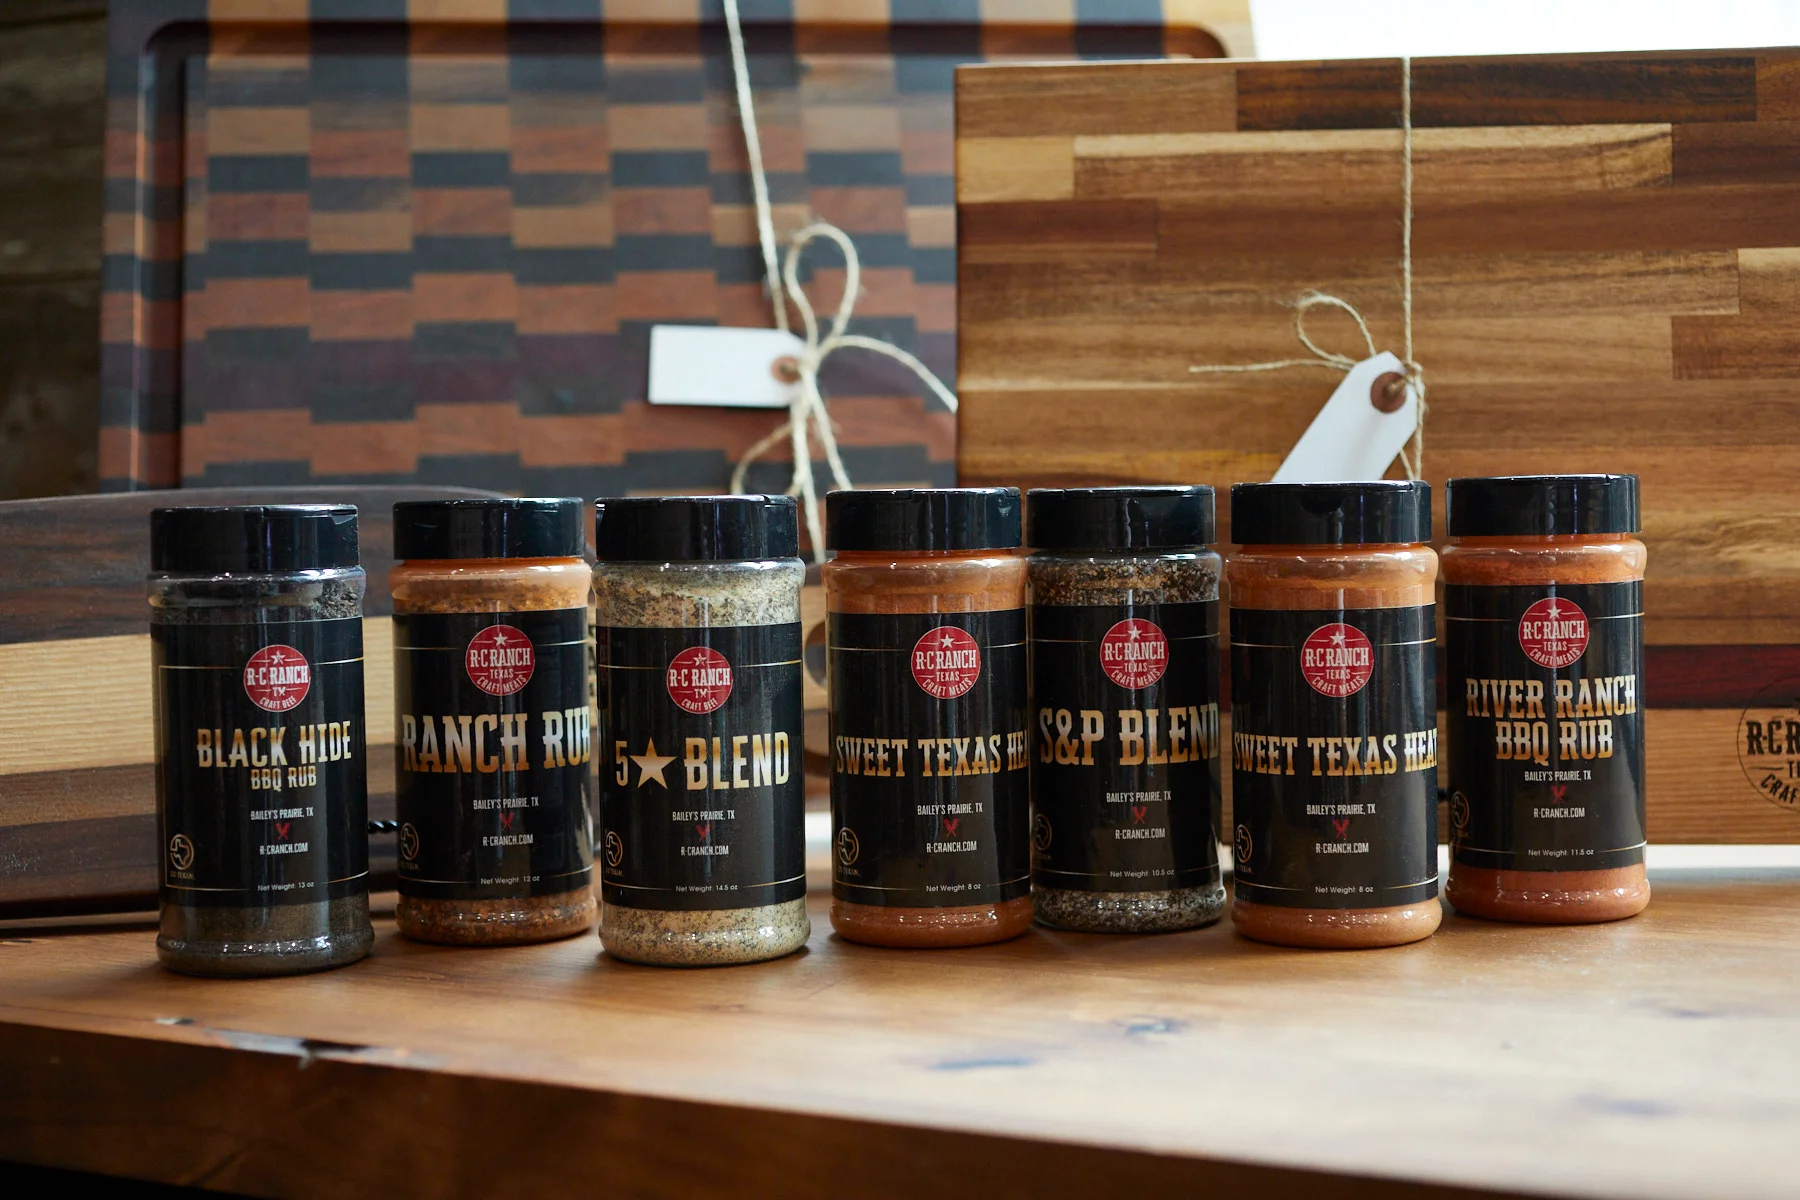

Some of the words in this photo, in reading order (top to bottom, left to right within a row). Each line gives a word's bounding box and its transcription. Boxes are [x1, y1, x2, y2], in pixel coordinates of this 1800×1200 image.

[1543, 620, 1585, 639] RANCH
[1124, 641, 1164, 660] RANCH
[1543, 642, 1567, 651] TEXAS
[490, 648, 530, 666] RANCH
[936, 650, 976, 669] RANCH
[1326, 648, 1370, 666] RANCH
[1530, 648, 1553, 665] CRAFT
[1556, 648, 1580, 665] MEATS
[270, 666, 308, 685] RANCH
[490, 670, 514, 679] TEXAS
[1124, 662, 1148, 672] TEXAS
[1326, 670, 1350, 680] TEXAS
[476, 676, 501, 693] CRAFT
[503, 675, 527, 693] MEATS
[692, 668, 730, 686] RANCH
[936, 672, 960, 682] TEXAS
[1111, 670, 1134, 686] CRAFT
[1138, 668, 1160, 686] MEATS
[1312, 676, 1337, 693] CRAFT
[1339, 676, 1365, 694] MEATS
[923, 678, 946, 696] CRAFT
[949, 678, 972, 697] MEATS
[260, 697, 281, 710] CRAFT
[282, 696, 297, 709] BEEF
[681, 698, 702, 712] CRAFT
[704, 698, 719, 711] BEEF
[1466, 678, 1546, 719] RIVER
[1555, 675, 1636, 718] RANCH
[402, 713, 530, 773] RANCH
[542, 706, 590, 769] RUB
[1040, 708, 1104, 766] S&P
[1118, 702, 1220, 766] BLEND
[197, 727, 287, 768] BLACK
[299, 720, 352, 764] HIDE
[1496, 722, 1549, 767] BBQ
[1559, 720, 1612, 760] RUB
[684, 732, 790, 790] BLEND
[836, 736, 908, 776] SWEET
[918, 734, 1001, 777] TEXAS
[1234, 732, 1298, 776] SWEET
[1308, 734, 1397, 776] TEXAS
[250, 768, 282, 792] BBQ
[288, 766, 317, 788] RUB
[1524, 771, 1553, 782] BAILEY'S
[1583, 770, 1592, 780] TX
[1106, 792, 1134, 803] BAILEY'S
[1164, 790, 1172, 800] TX
[1760, 773, 1800, 804] CRAF
[473, 798, 502, 810] BAILEY'S
[531, 796, 540, 807] TX
[917, 804, 946, 816] BAILEY'S
[975, 802, 983, 813] TX
[1306, 804, 1336, 816] BAILEY'S
[1367, 803, 1376, 814] TX
[250, 809, 278, 820] BAILEY'S
[306, 806, 314, 817] TX
[672, 811, 698, 822] BAILEY'S
[727, 810, 735, 820] TX
[260, 842, 308, 856] R-CRANCH.COM
[926, 840, 977, 854] R-CRANCH.COM
[1316, 842, 1369, 854] R-CRANCH.COM
